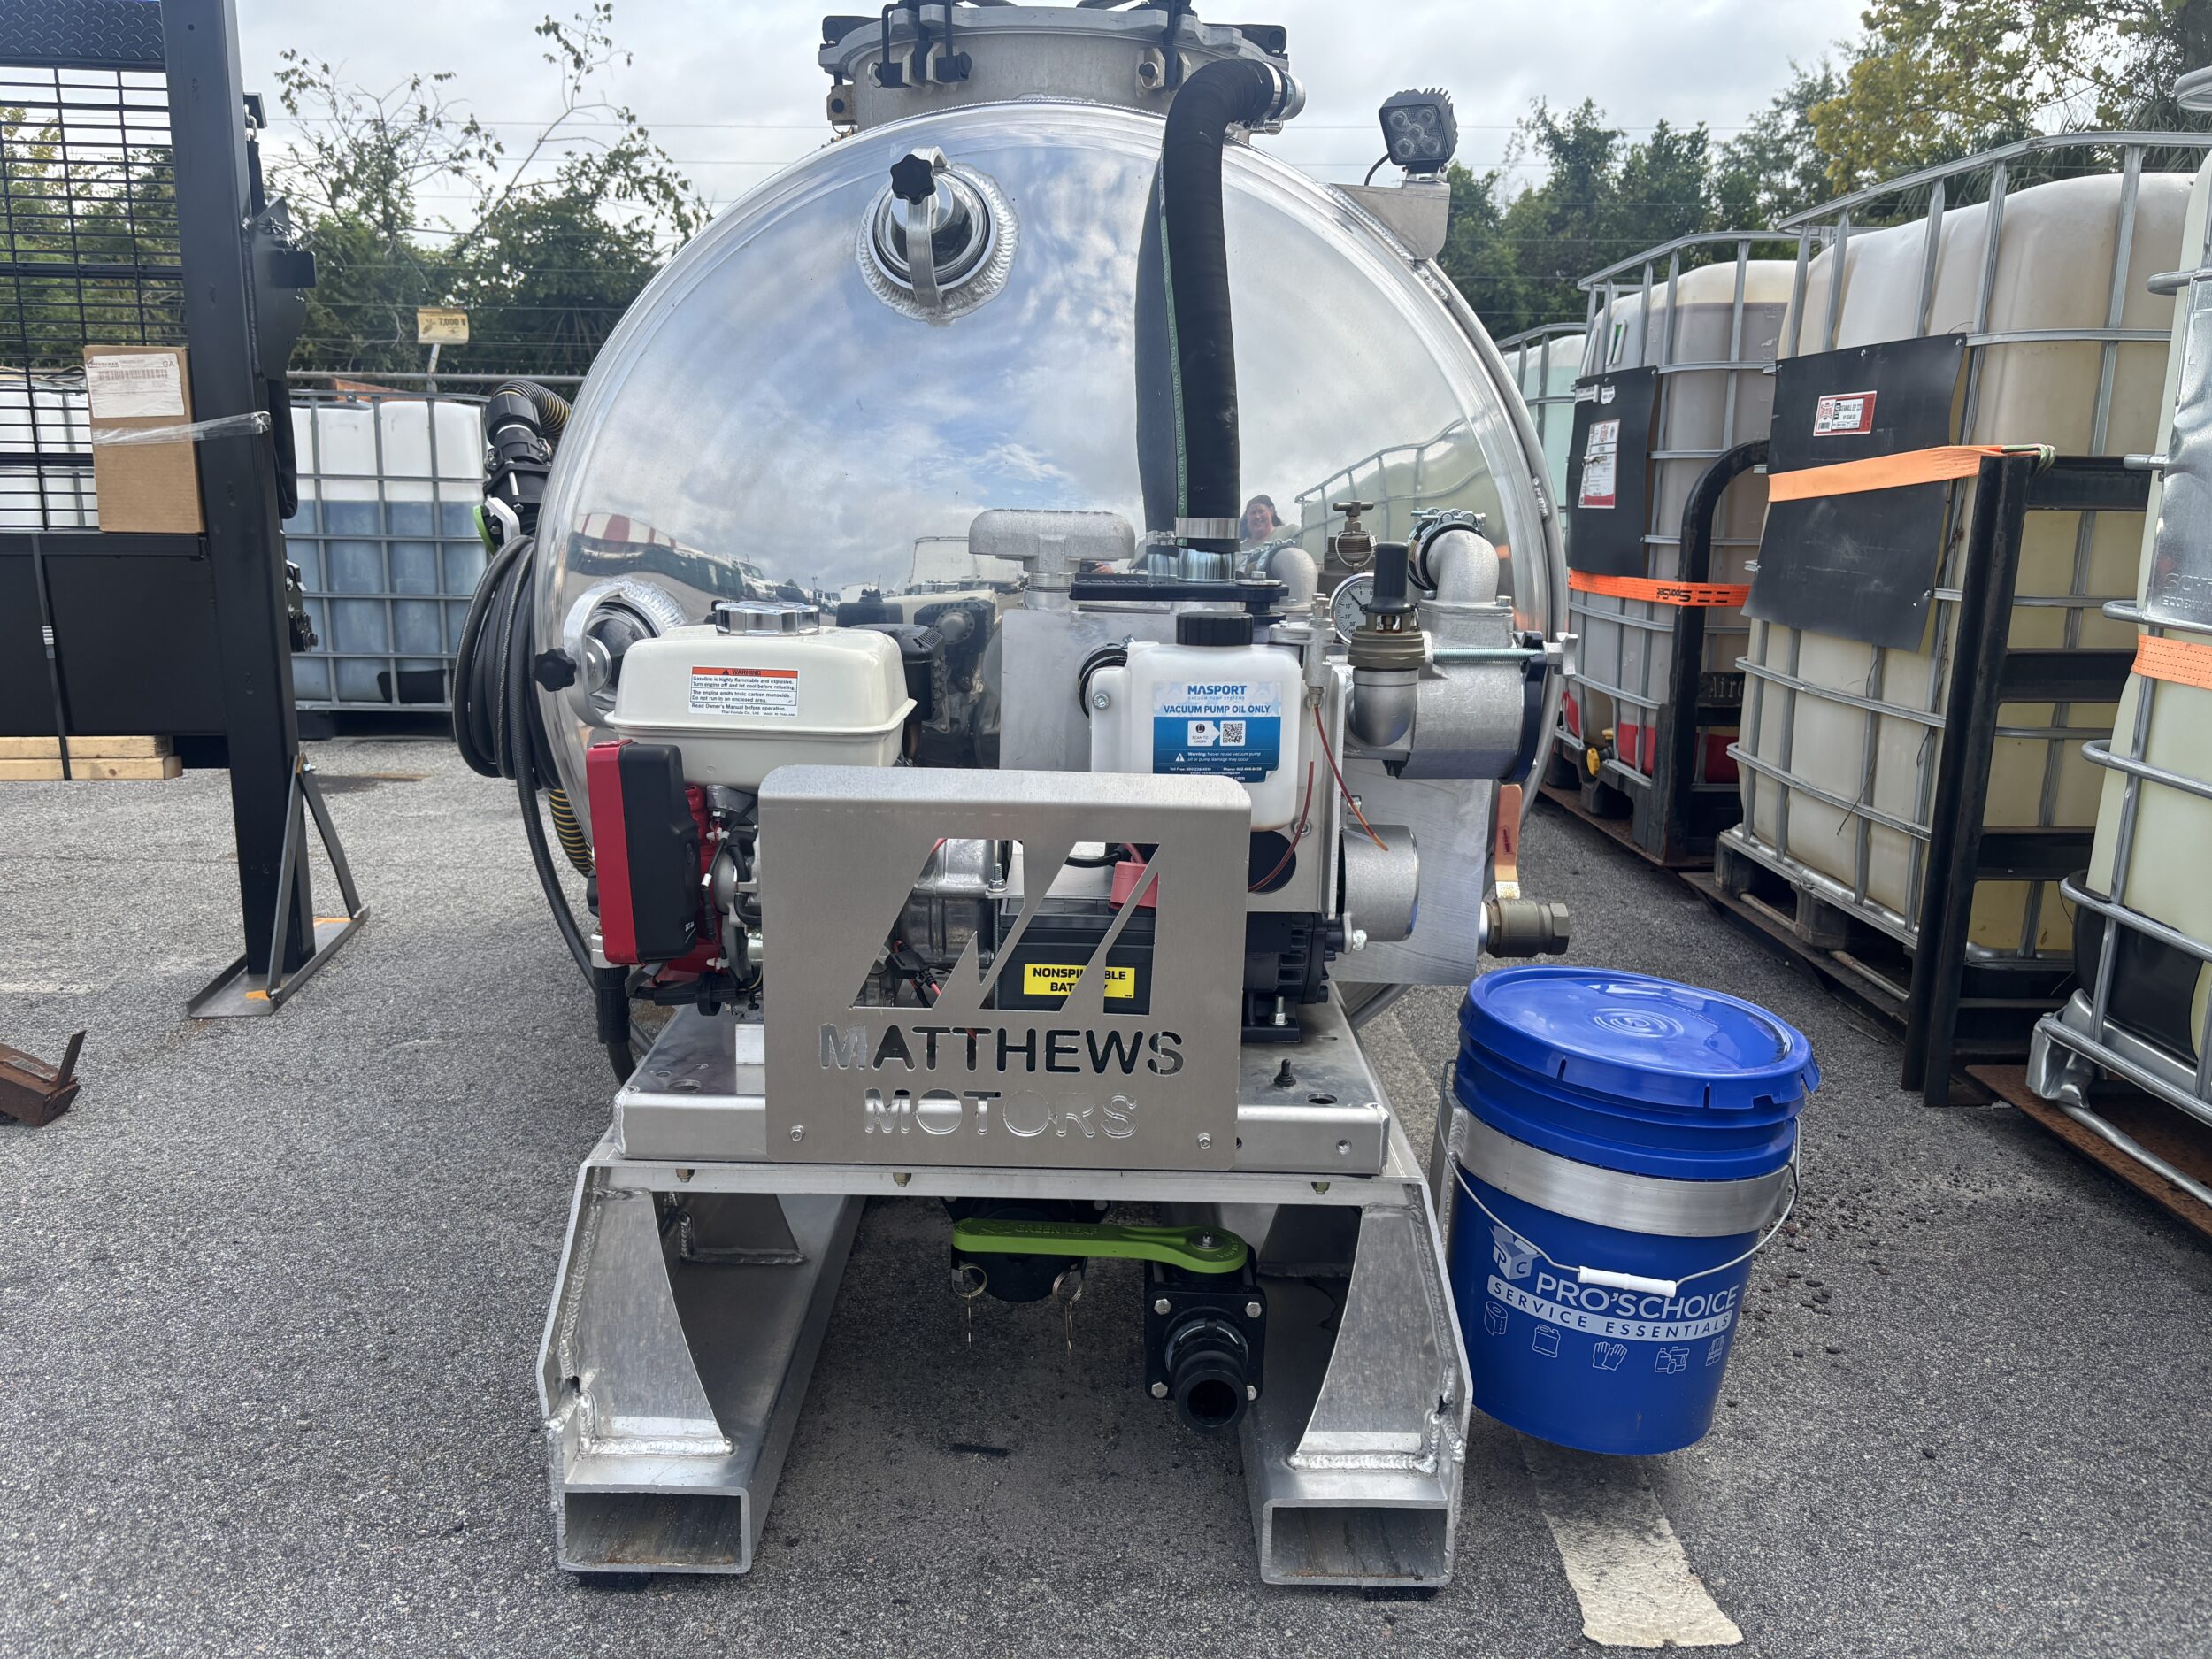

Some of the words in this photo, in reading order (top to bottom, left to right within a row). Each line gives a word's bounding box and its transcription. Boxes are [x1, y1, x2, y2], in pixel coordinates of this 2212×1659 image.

[2164, 572, 2212, 594] SCH
[1187, 685, 1248, 695] MASPORT
[1164, 705, 1202, 714] VACUUM
[1204, 705, 1231, 714] PUMP
[1233, 705, 1247, 714] OIL
[1248, 705, 1271, 714] ONLY
[1033, 967, 1126, 980] NONSPIBLE
[819, 1023, 1185, 1076] MATTHEWS
[864, 1088, 1139, 1139] MOTORS
[1016, 1224, 1061, 1233] GREEN
[1065, 1227, 1098, 1236] LEAF
[1494, 1282, 1587, 1328] SERVICE
[1605, 1316, 1729, 1339] ESSENTIALS
